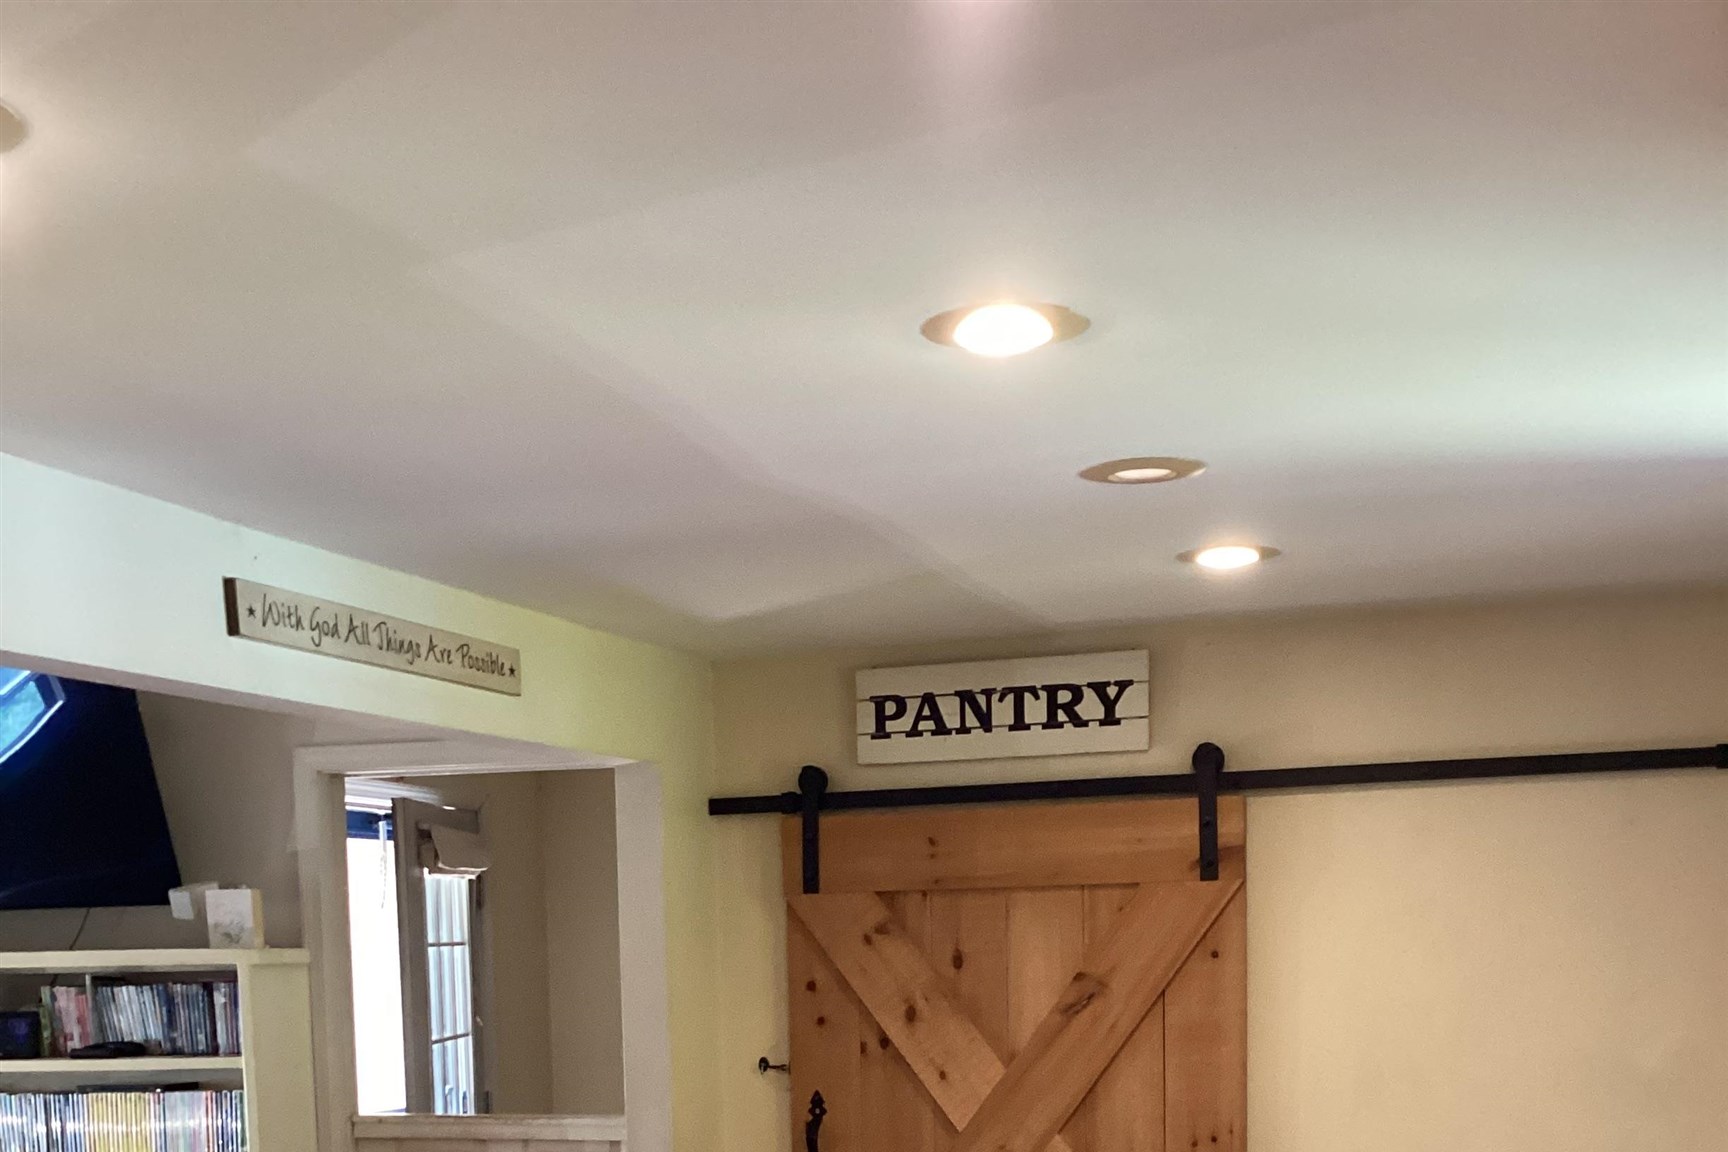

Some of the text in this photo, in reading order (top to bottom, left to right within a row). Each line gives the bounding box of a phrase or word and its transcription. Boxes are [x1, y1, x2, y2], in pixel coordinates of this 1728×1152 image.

[262, 593, 506, 677] With God All Things Are Possible
[869, 679, 1134, 740] PANTRY
